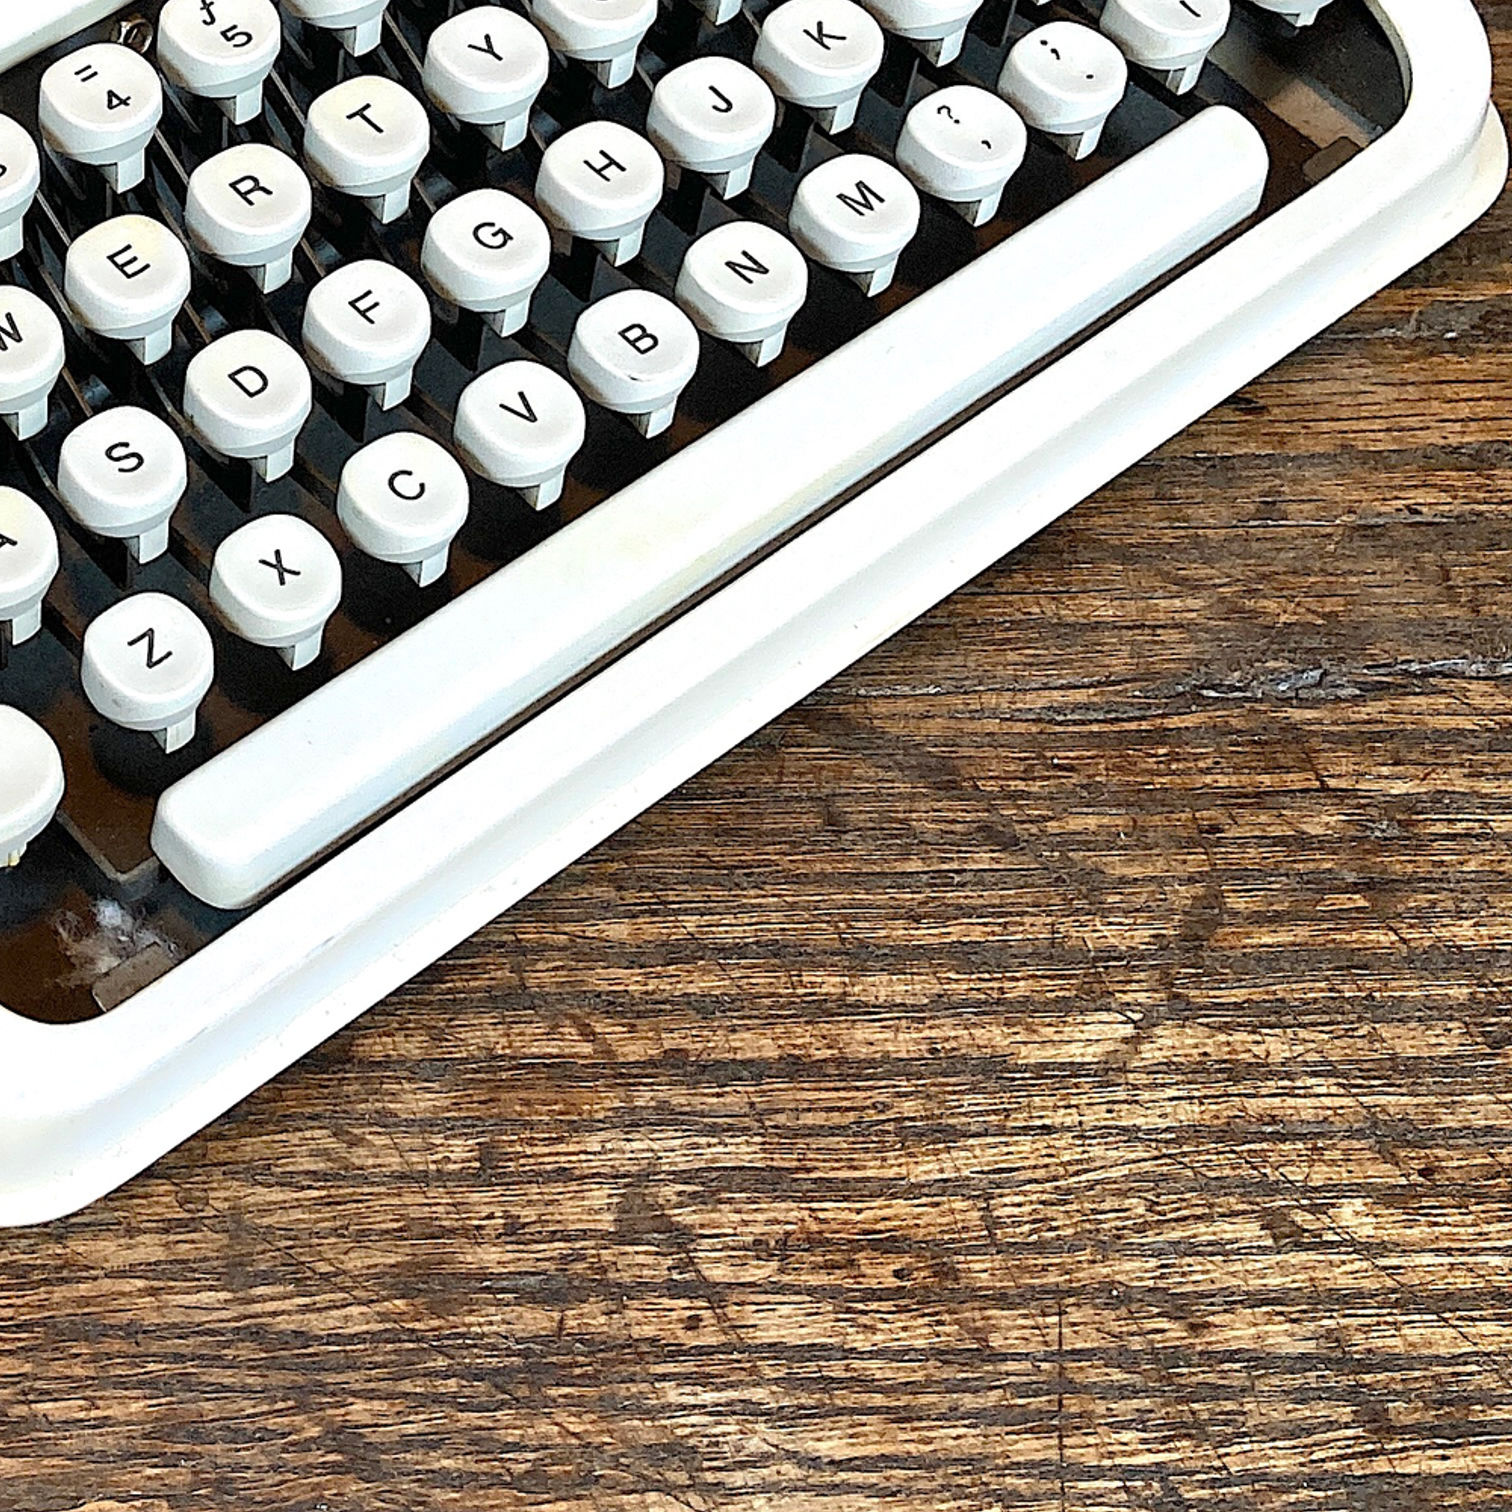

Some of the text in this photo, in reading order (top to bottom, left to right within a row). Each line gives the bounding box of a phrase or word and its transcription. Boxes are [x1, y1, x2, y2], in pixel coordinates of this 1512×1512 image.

[219, 24, 253, 48] 5
[467, 33, 504, 62] Y
[802, 20, 847, 51] K
[106, 89, 132, 111] 4
[708, 85, 733, 114] J
[936, 104, 961, 125] ?
[345, 102, 384, 134] T
[583, 149, 627, 183] H
[228, 175, 274, 207] R
[835, 180, 886, 217] M
[472, 221, 514, 250] G
[106, 243, 151, 280] E
[724, 249, 770, 285] N
[347, 289, 380, 325] F
[617, 323, 659, 355] B
[227, 365, 269, 399] D
[498, 391, 538, 424] V
[104, 441, 145, 473] S
[387, 469, 426, 501] C
[258, 548, 301, 587] X
[127, 627, 173, 670] Z
